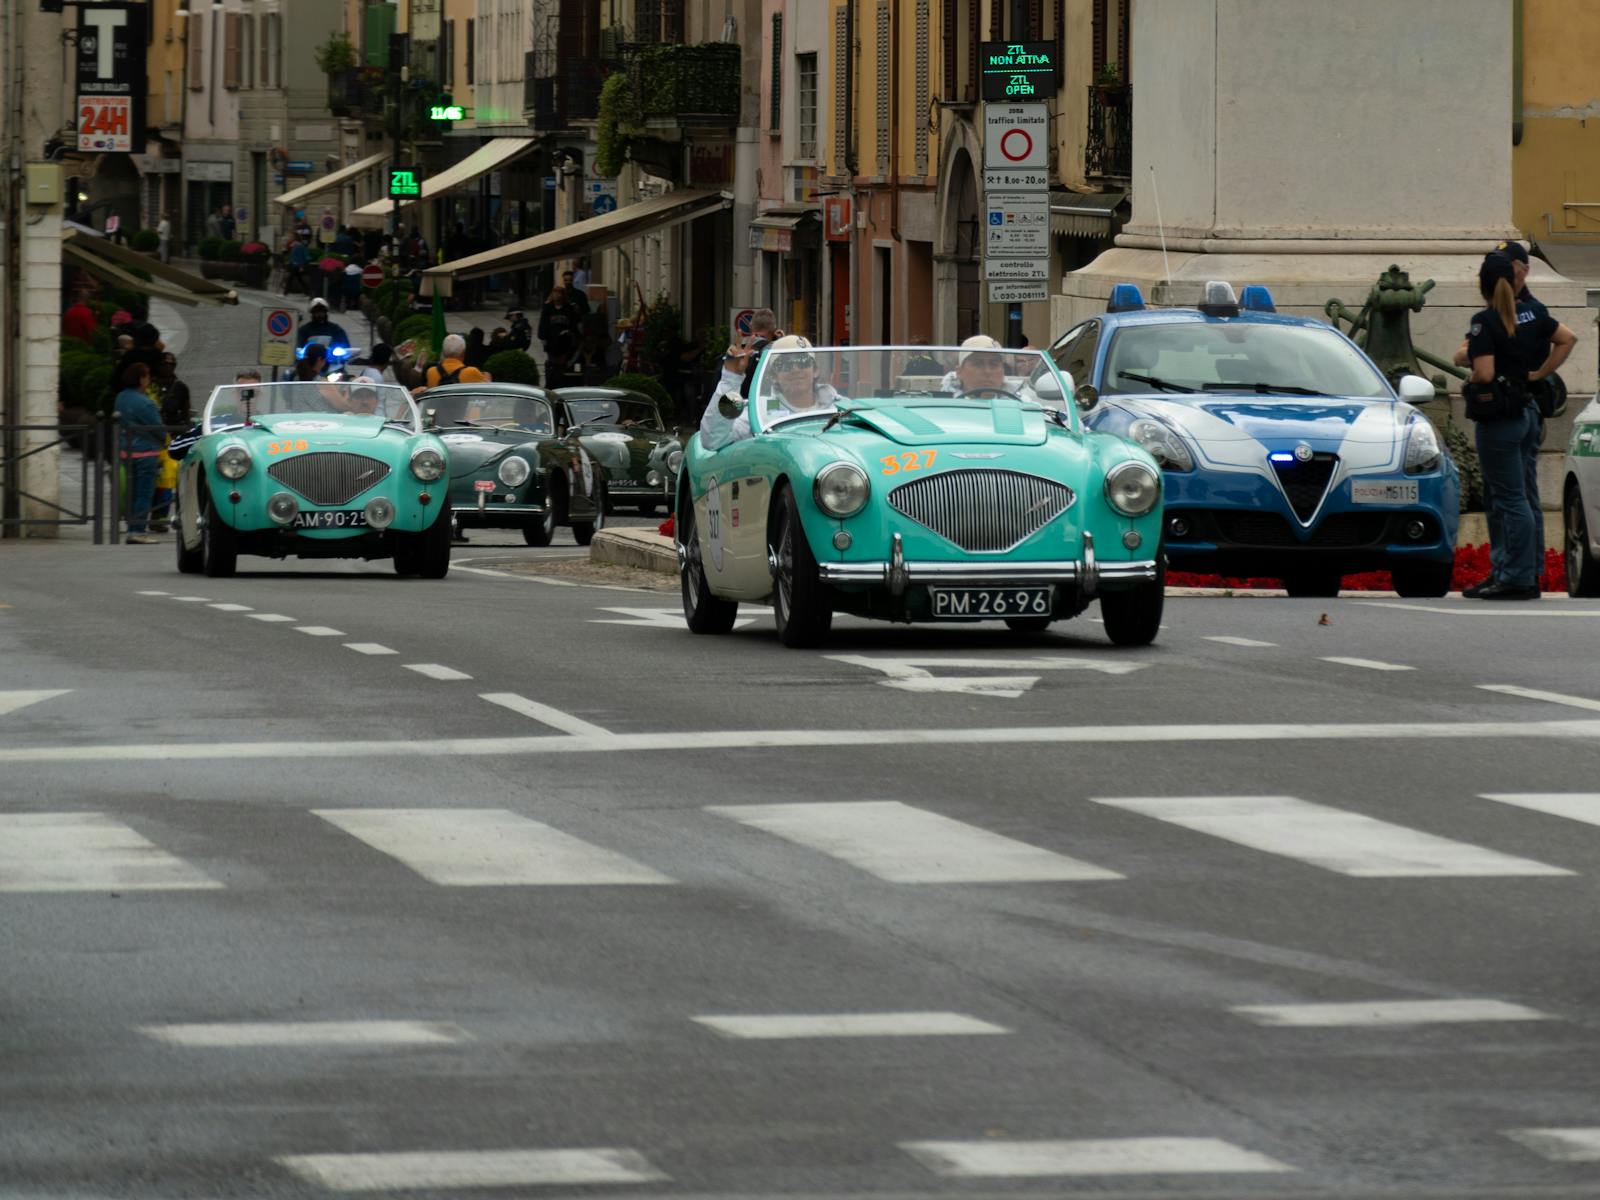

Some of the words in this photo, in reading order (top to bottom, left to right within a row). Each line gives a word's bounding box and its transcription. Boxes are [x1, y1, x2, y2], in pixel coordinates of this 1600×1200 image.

[84, 8, 127, 79] T
[1007, 44, 1026, 55] ZTL
[989, 55, 1013, 65] NON
[1015, 54, 1050, 65] ATTIVA
[1010, 74, 1030, 85] ZTL
[1005, 84, 1035, 95] OPEN
[80, 105, 128, 135] 24H
[988, 116, 1015, 124] traffico
[1017, 115, 1045, 124] limitato
[391, 171, 419, 187] ZTL
[880, 449, 938, 476] 327
